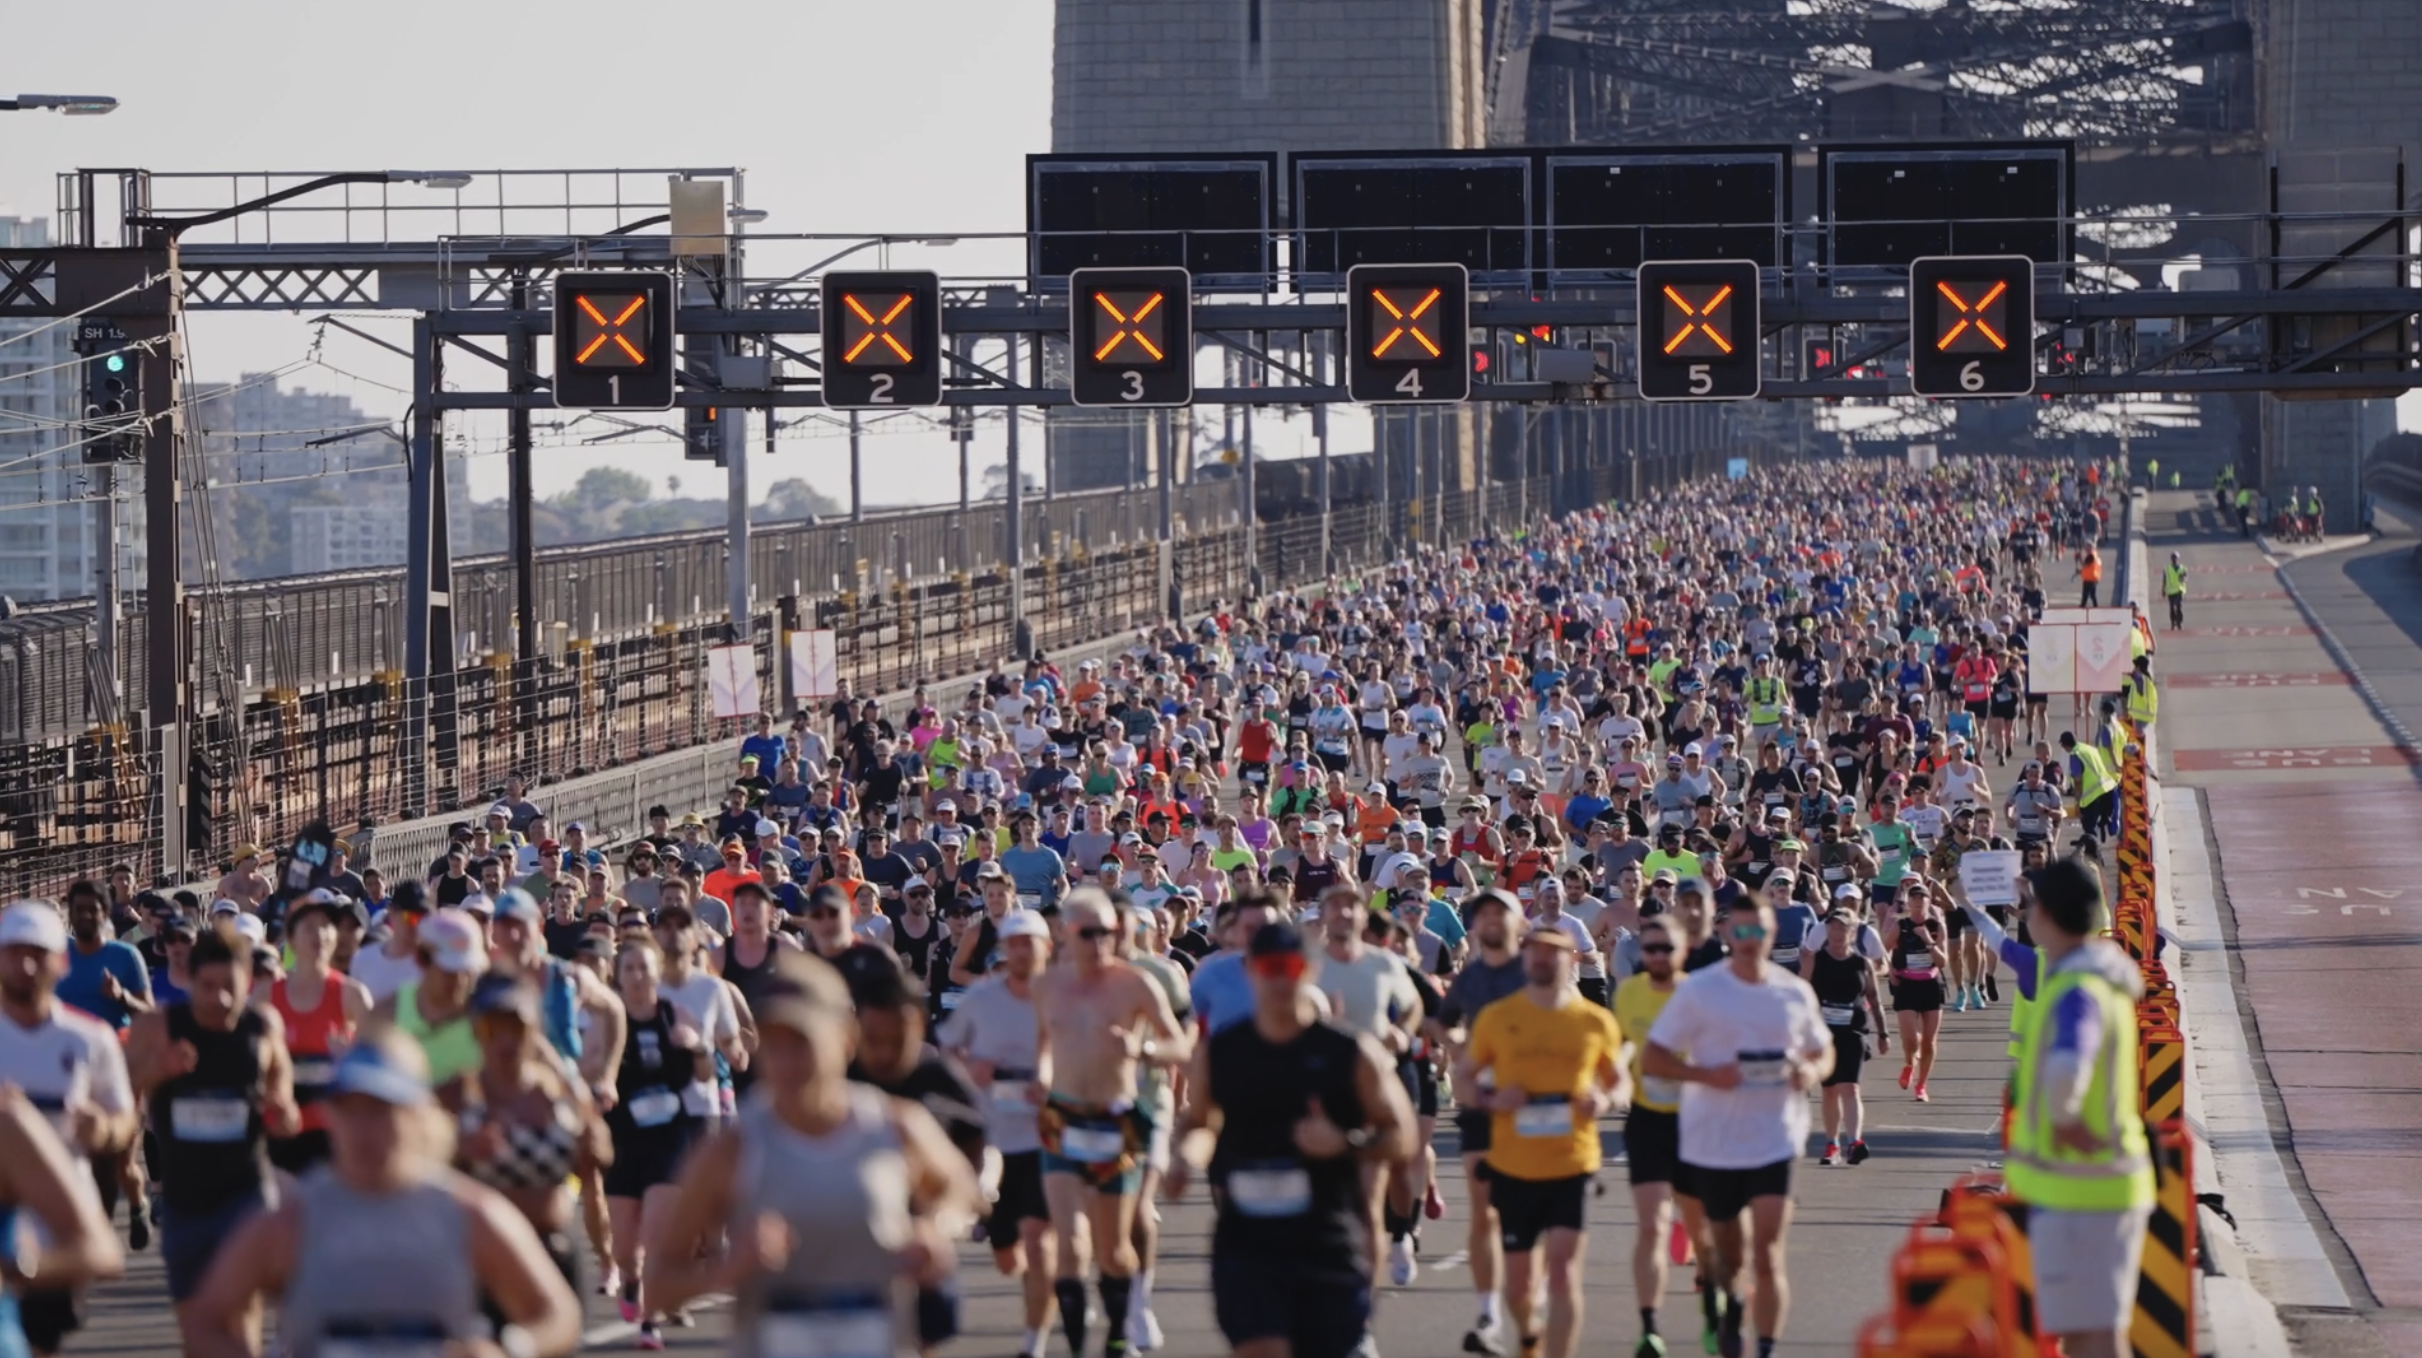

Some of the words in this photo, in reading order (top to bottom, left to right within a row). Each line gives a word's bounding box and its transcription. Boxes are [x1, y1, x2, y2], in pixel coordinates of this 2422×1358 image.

[84, 327, 103, 339] SH
[608, 374, 619, 405] 1
[870, 373, 894, 403] 2
[1120, 370, 1144, 401] 3
[1395, 367, 1423, 397] 4
[1689, 364, 1713, 395] 5
[1960, 360, 1985, 391] 6
